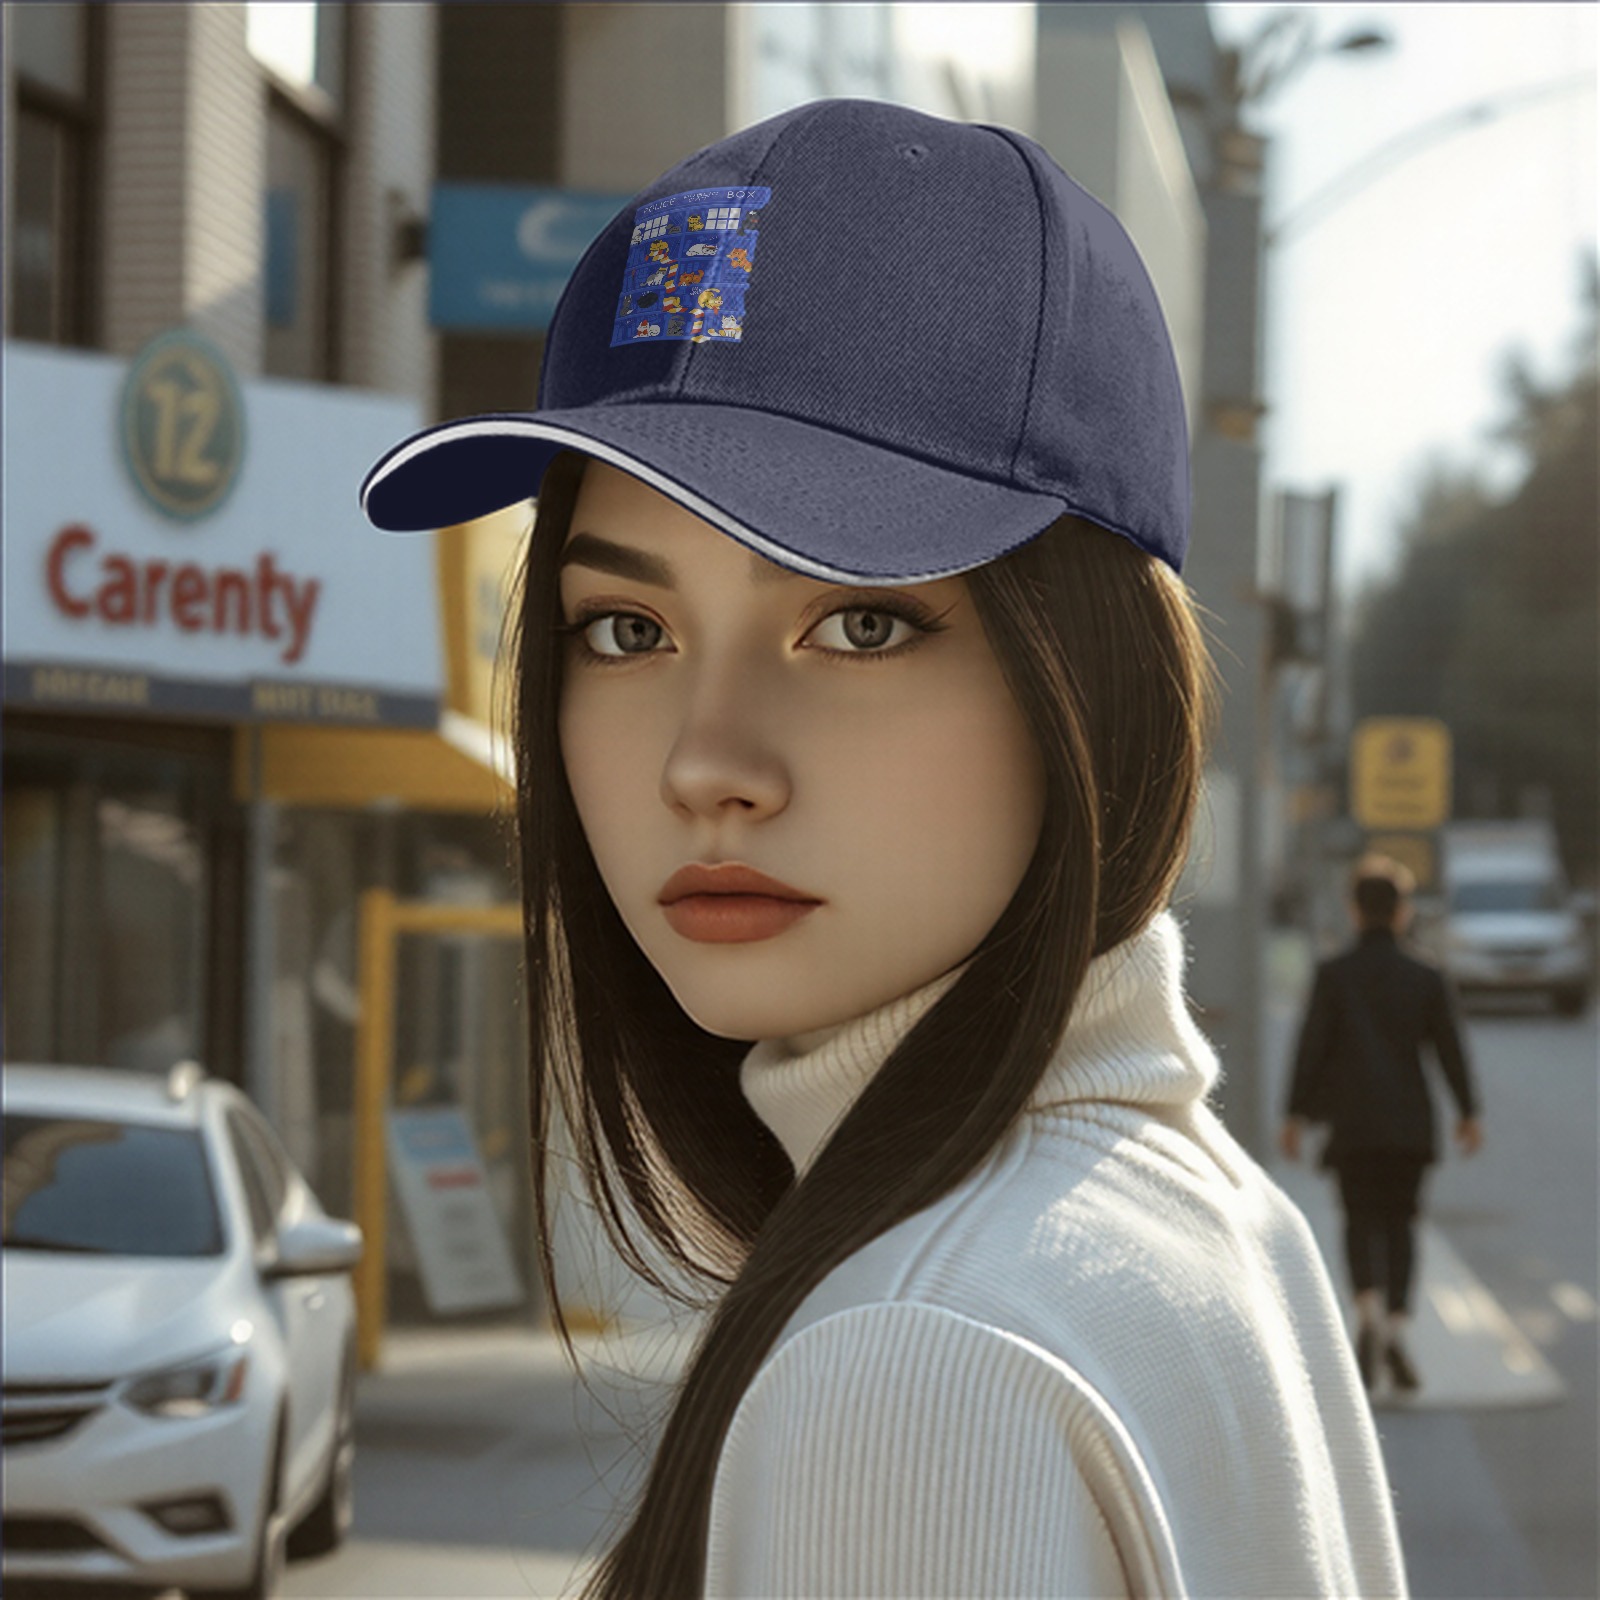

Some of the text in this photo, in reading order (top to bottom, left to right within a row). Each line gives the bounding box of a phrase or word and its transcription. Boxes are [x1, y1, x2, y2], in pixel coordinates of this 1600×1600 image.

[726, 190, 756, 199] BOX
[148, 381, 221, 483] 12
[44, 522, 321, 666] Carenty
